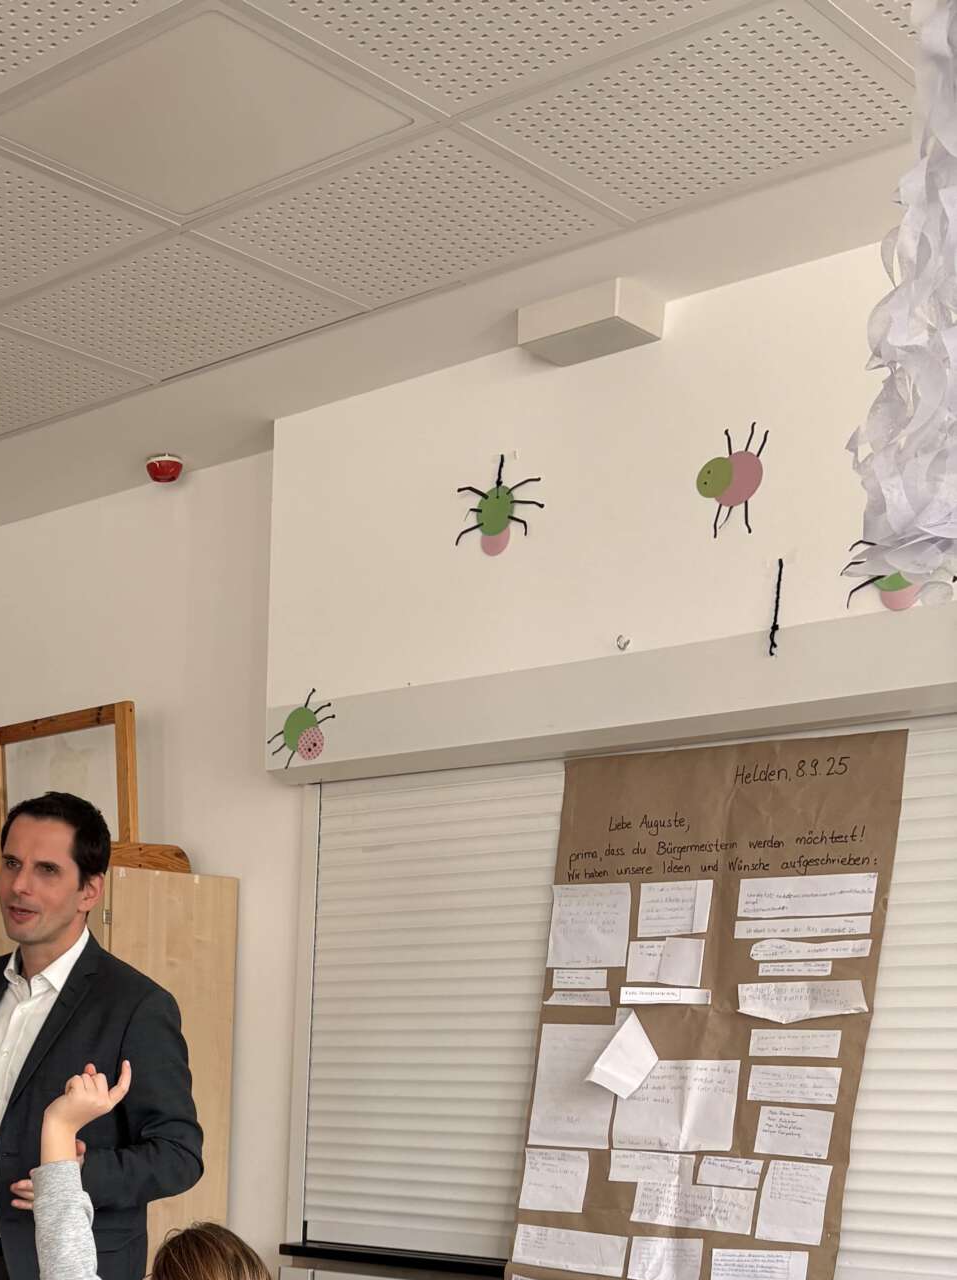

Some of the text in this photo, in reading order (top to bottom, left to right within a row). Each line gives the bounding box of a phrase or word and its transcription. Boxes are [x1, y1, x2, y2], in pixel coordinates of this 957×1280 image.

[608, 811, 691, 837] Liebe Auguste,
[604, 843, 626, 857] dass
[632, 841, 647, 856] du
[656, 837, 738, 861] Bürgermeisterin
[748, 835, 786, 849] werden
[567, 871, 580, 883] Wir
[584, 869, 609, 879] haben
[616, 866, 654, 875] unsere
[662, 859, 692, 875] Ideen
[700, 860, 719, 873] und
[728, 856, 771, 872] Wünsche
